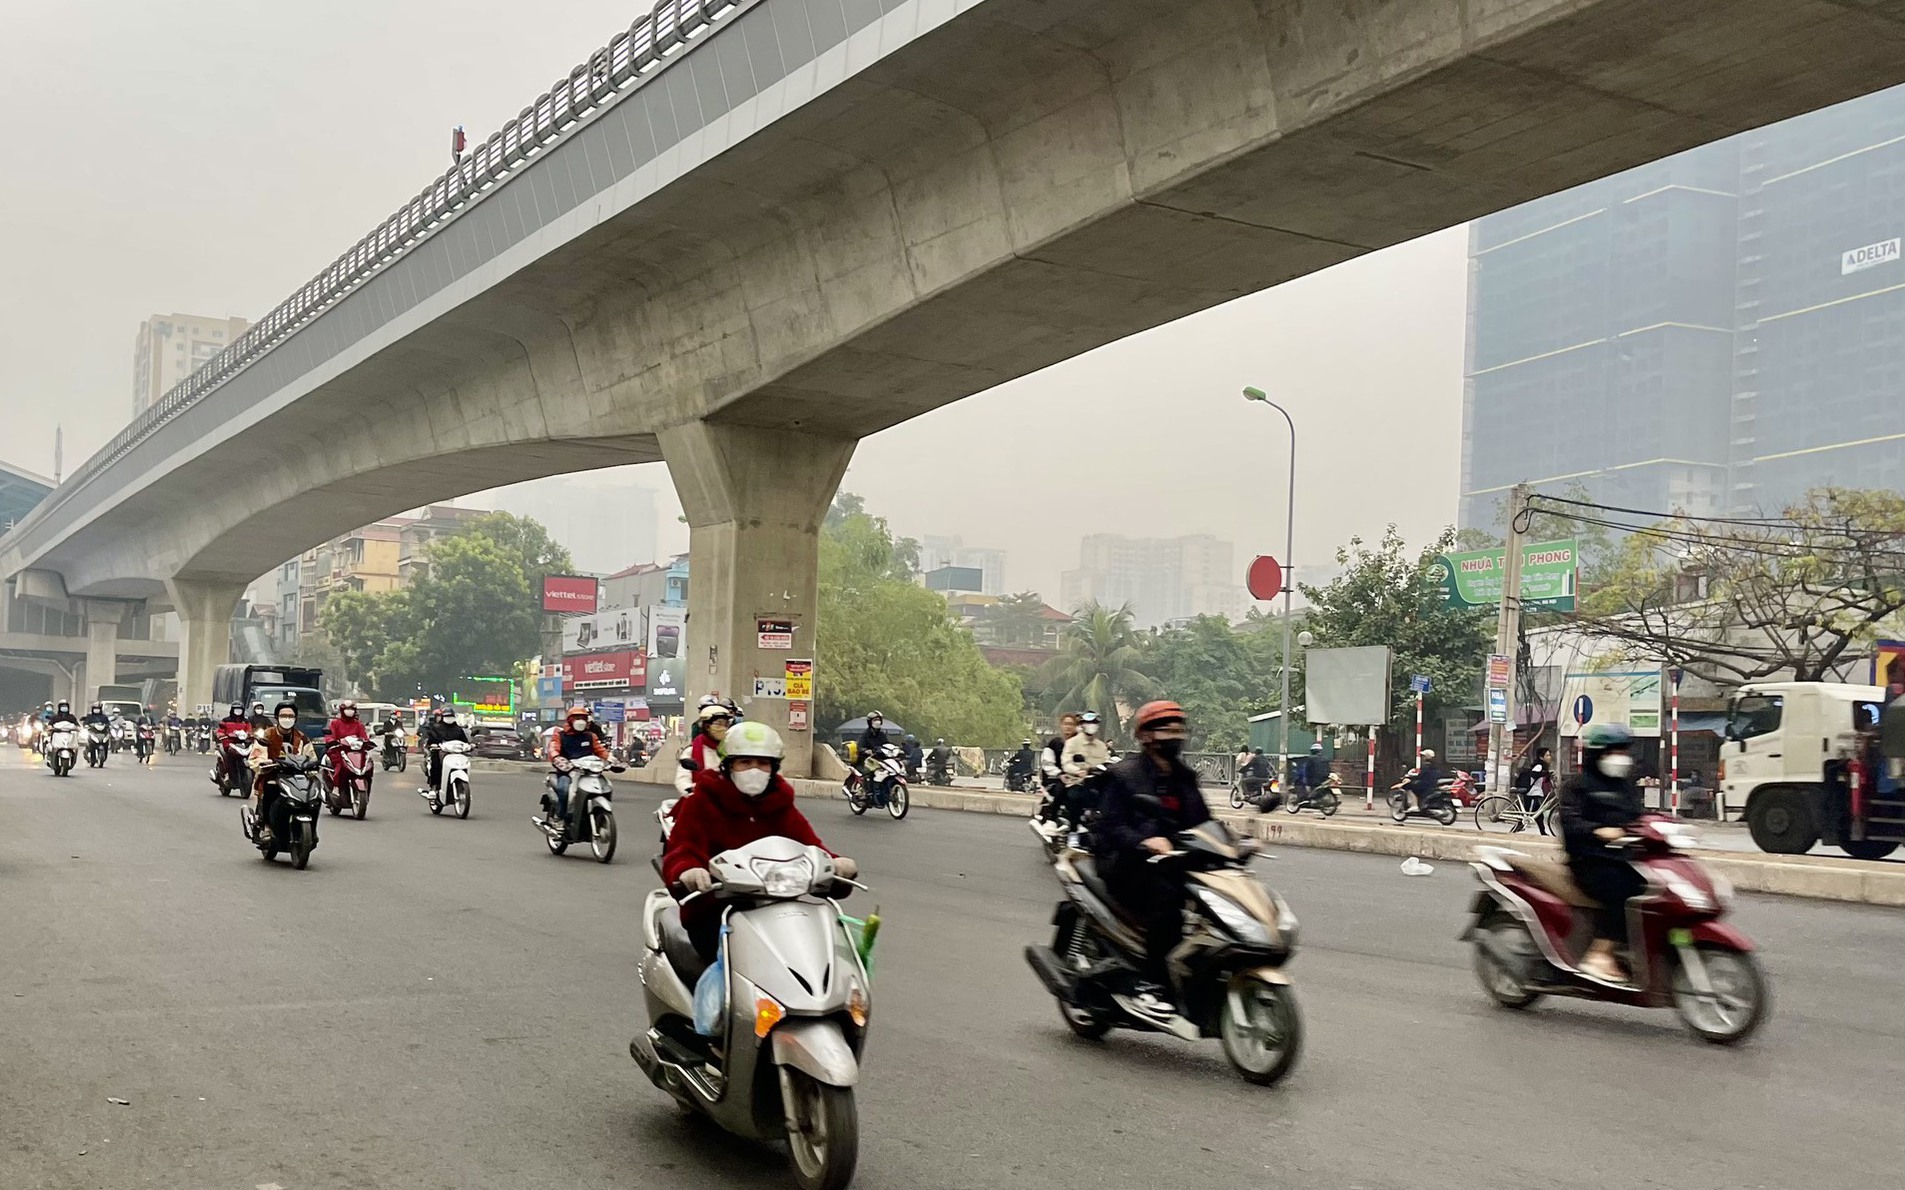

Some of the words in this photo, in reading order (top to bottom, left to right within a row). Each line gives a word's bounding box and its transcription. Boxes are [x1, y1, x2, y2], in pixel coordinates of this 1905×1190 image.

[1857, 241, 1897, 263] DELTA
[1461, 557, 1492, 573] NHỰA
[1529, 551, 1571, 564] PHONG
